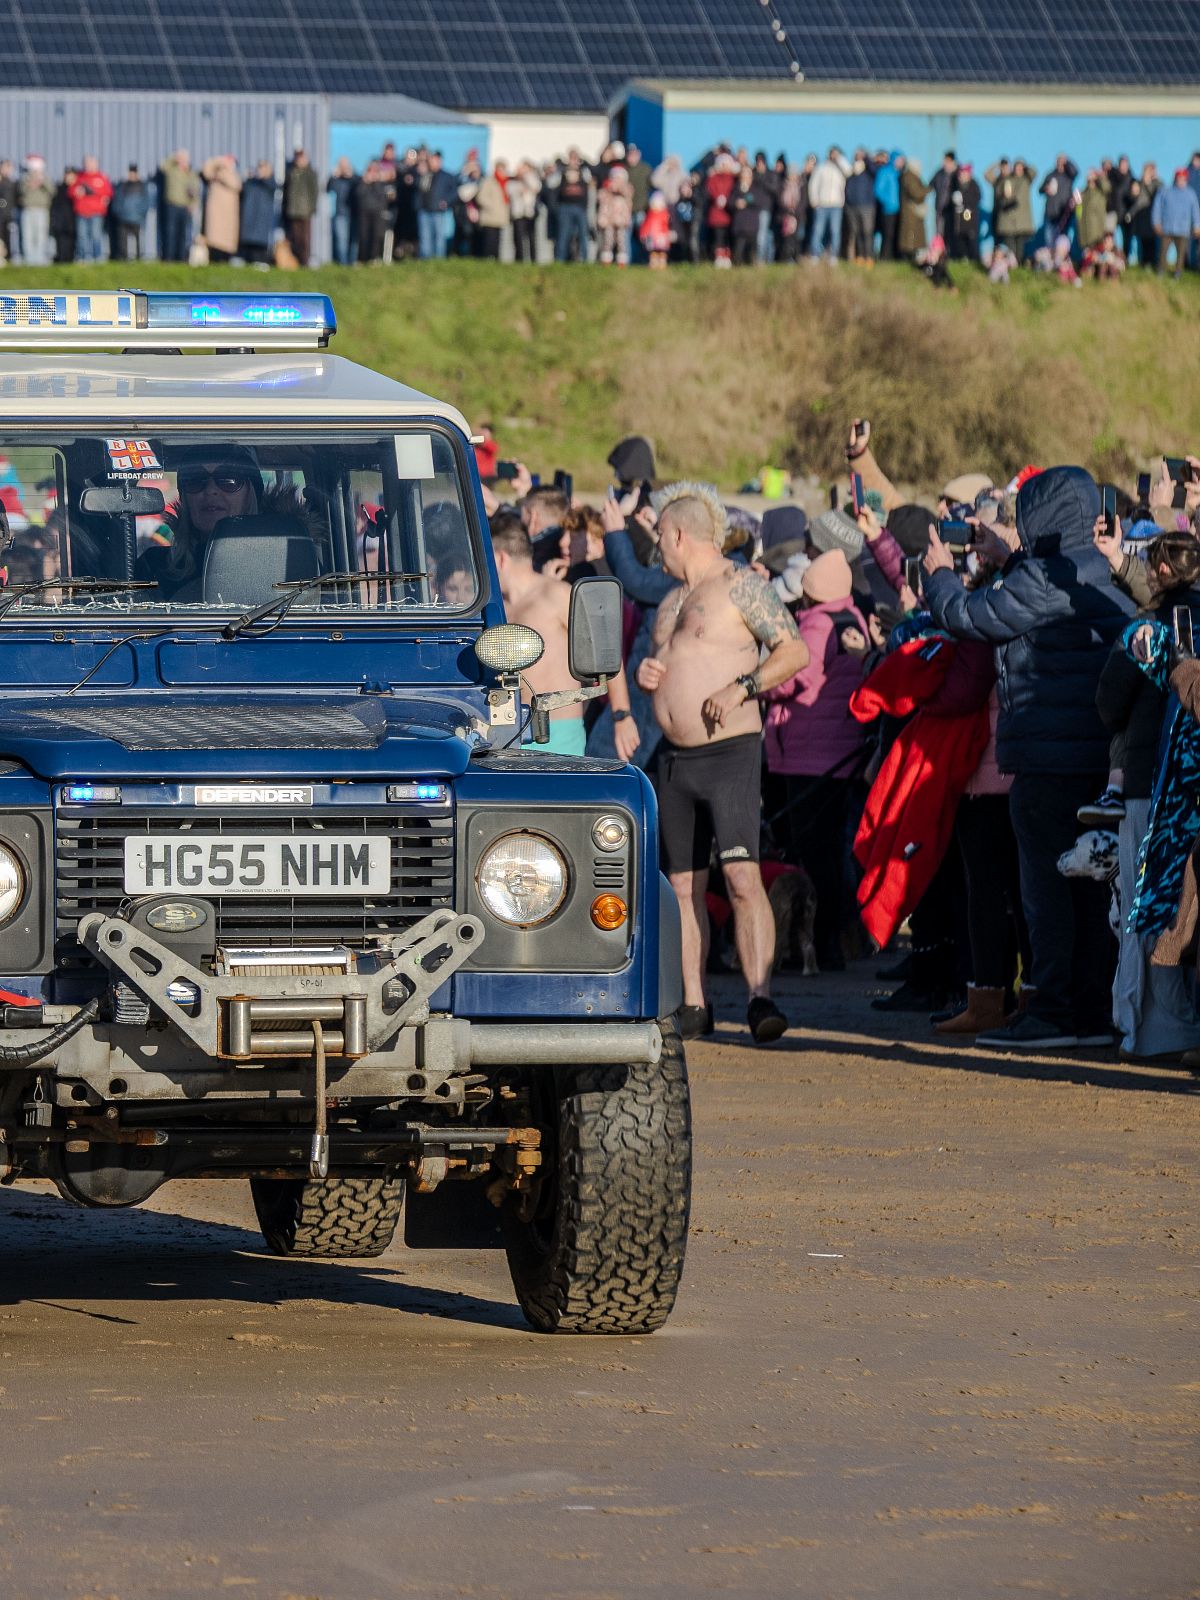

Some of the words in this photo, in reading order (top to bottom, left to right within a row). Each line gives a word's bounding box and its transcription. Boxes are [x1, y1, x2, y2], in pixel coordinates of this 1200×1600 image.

[107, 472, 142, 480] LIFEBOAT
[142, 472, 164, 480] CREW
[202, 789, 304, 803] DEFENDER
[145, 844, 266, 886] HG55
[281, 844, 370, 886] NHM
